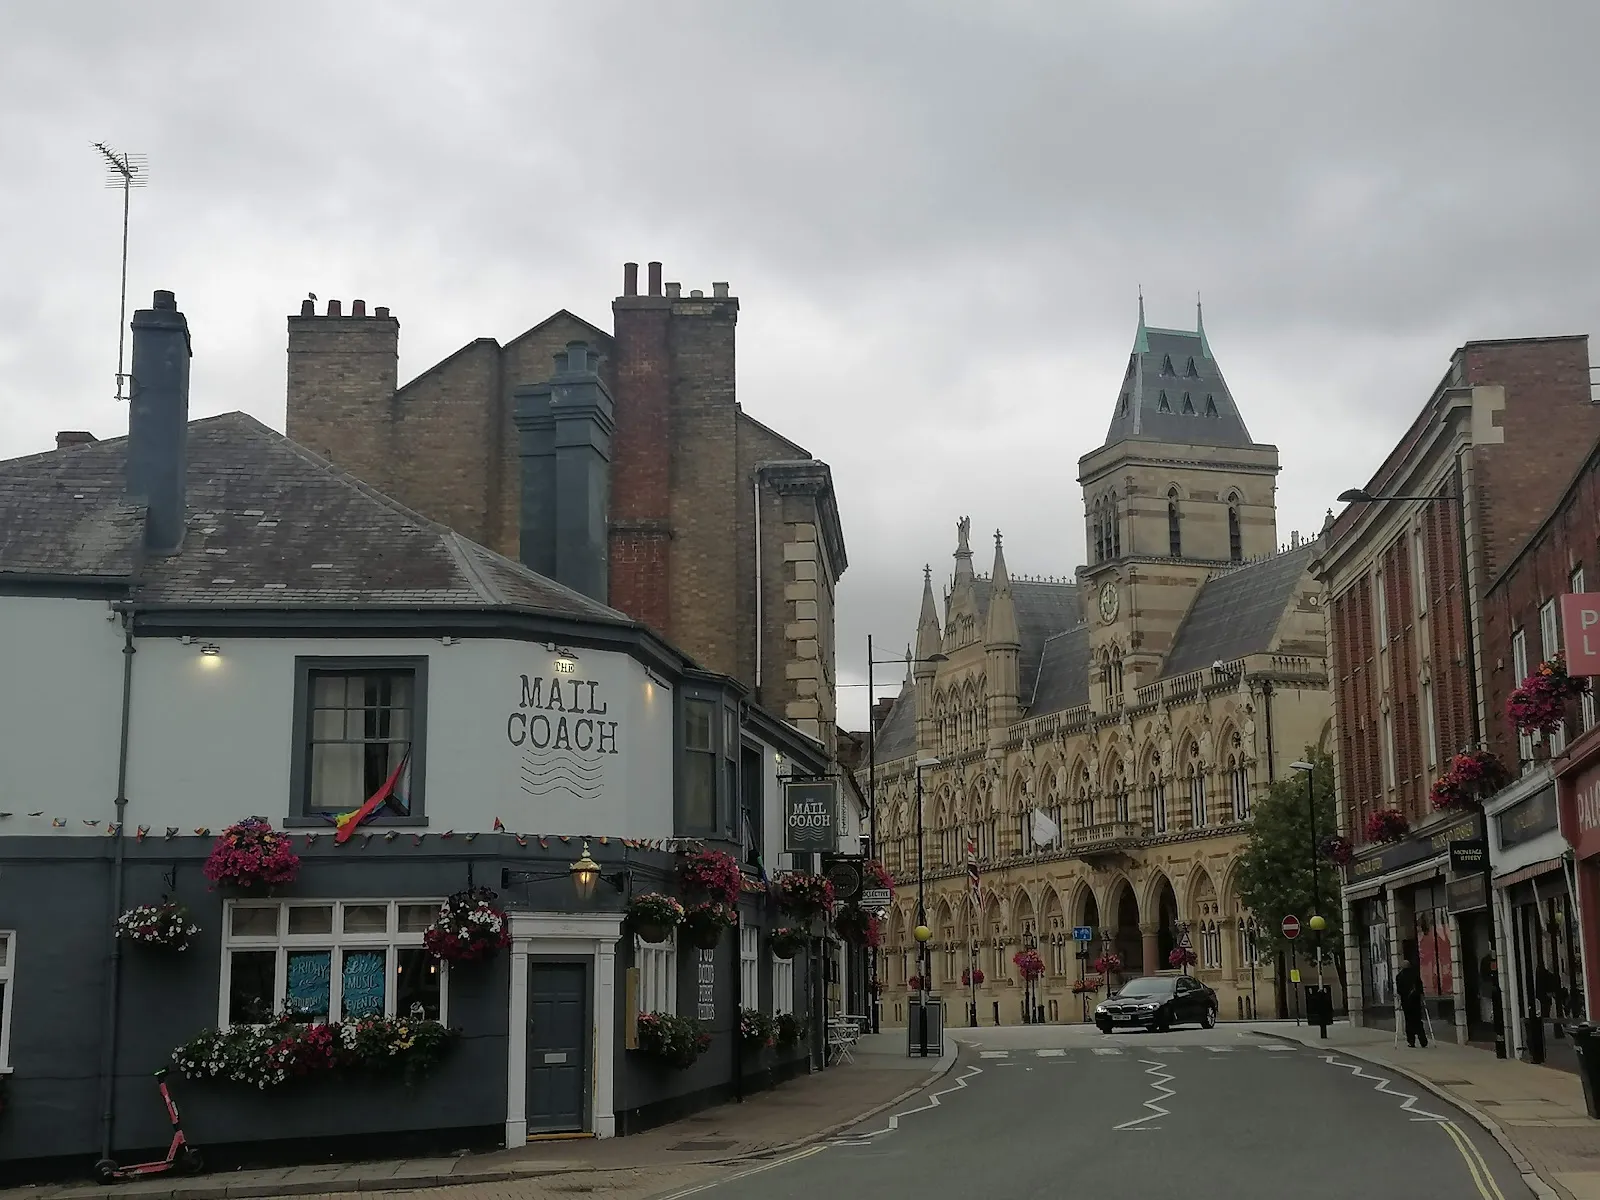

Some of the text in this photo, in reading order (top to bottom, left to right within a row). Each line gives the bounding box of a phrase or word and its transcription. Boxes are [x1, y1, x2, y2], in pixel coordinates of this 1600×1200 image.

[554, 661, 575, 673] THE
[519, 674, 607, 715] MAIL
[507, 712, 619, 754] COACH
[793, 802, 827, 814] MAIL
[789, 814, 831, 827] COACH
[292, 961, 330, 979] FRIDAY
[347, 975, 380, 989] MUSIC
[347, 996, 380, 1011] EVENTS
